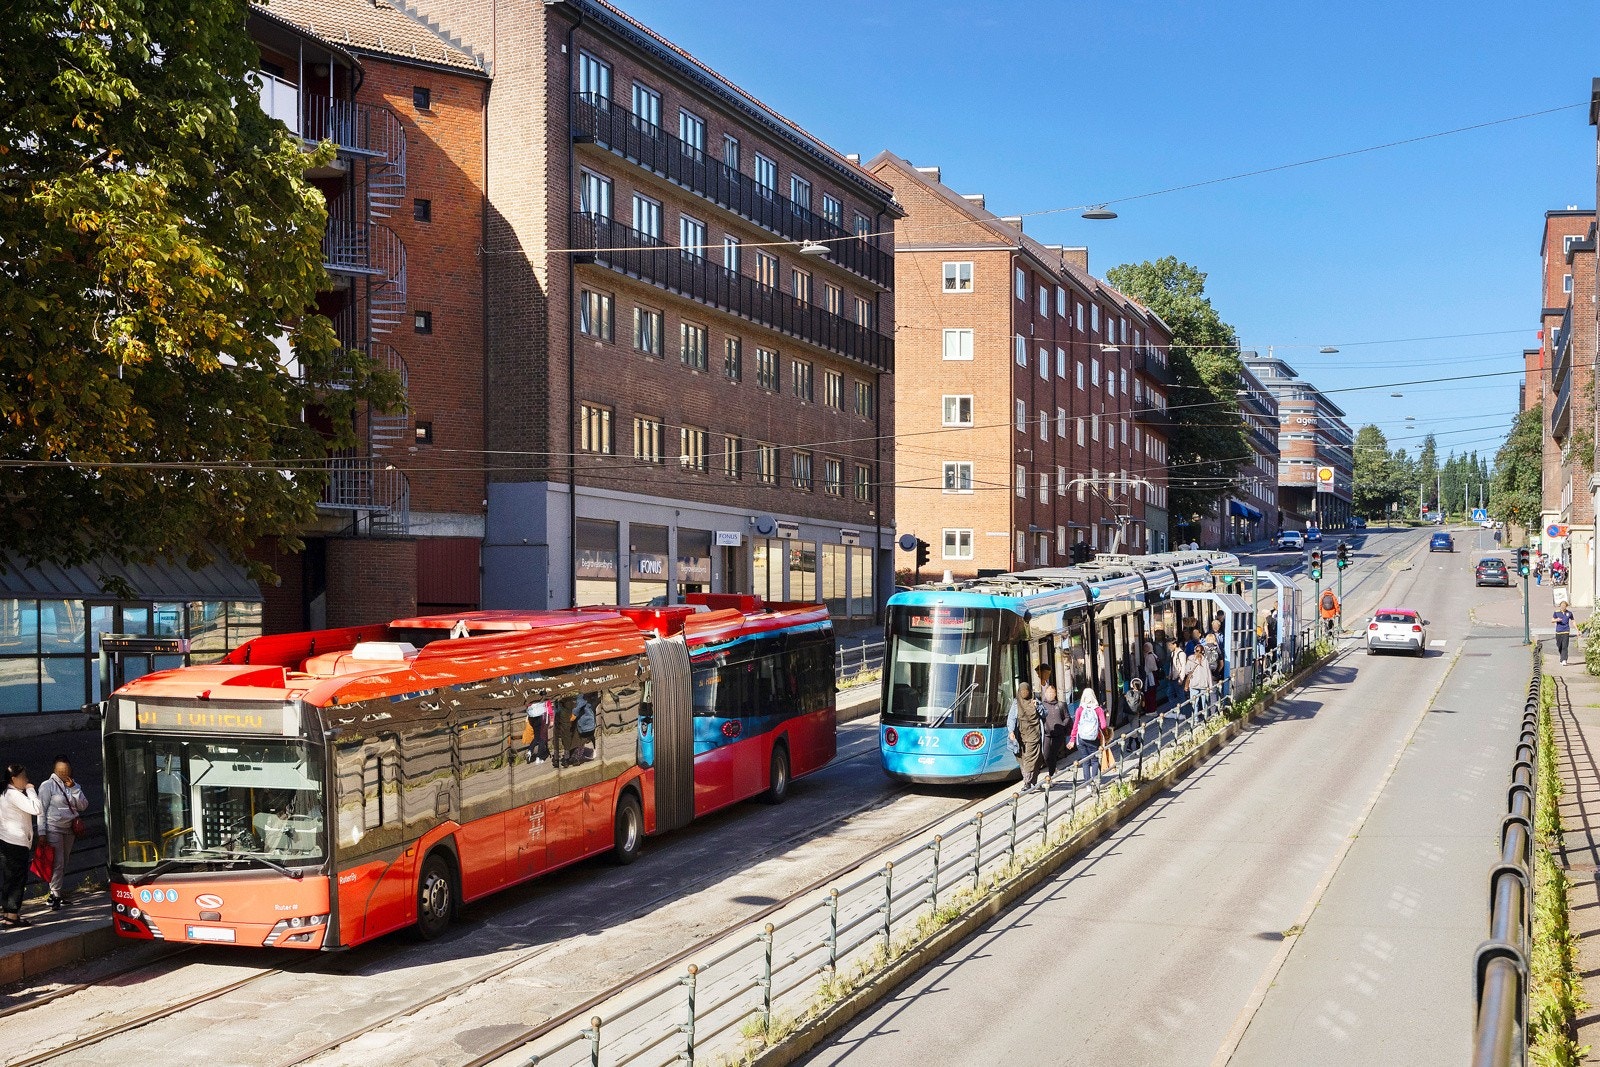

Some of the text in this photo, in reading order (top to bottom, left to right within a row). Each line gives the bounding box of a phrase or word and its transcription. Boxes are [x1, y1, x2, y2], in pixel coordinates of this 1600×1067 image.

[640, 560, 662, 574] FONUS
[917, 735, 940, 748] 472
[123, 891, 134, 900] 253
